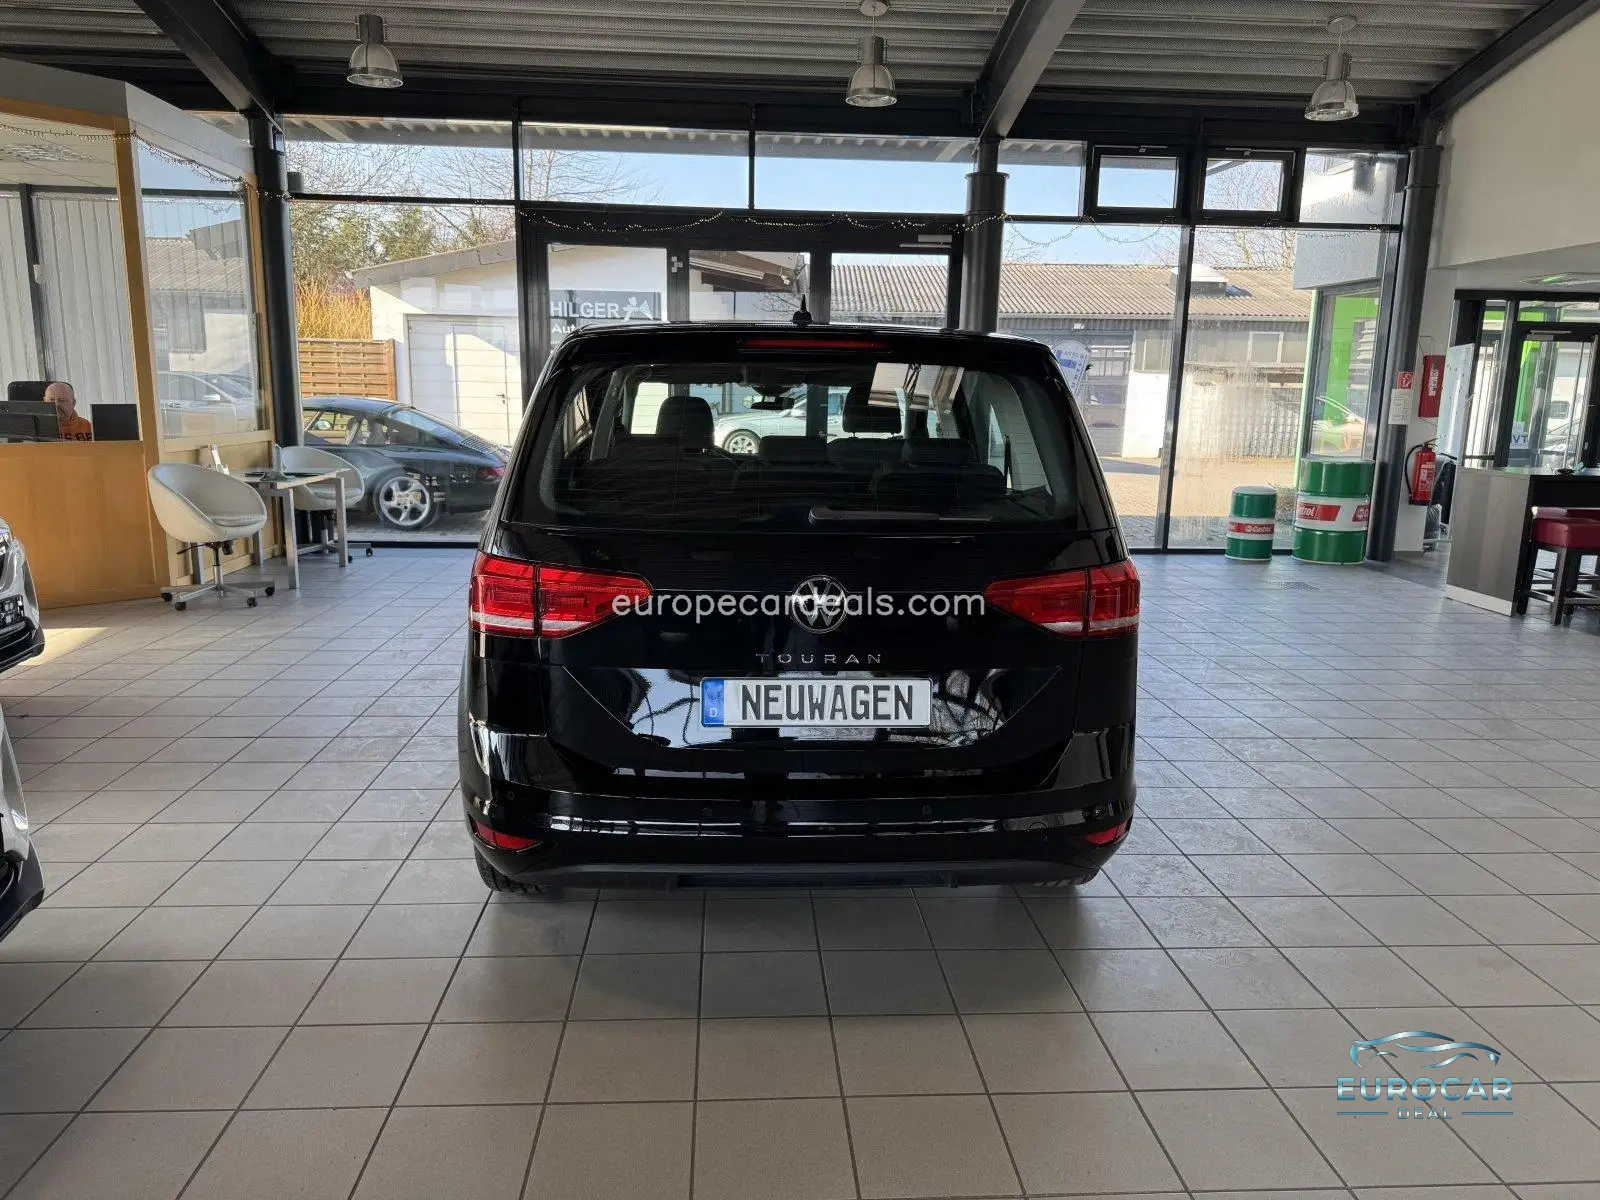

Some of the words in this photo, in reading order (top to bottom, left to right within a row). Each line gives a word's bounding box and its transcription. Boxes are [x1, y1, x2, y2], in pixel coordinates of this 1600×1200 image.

[550, 301, 621, 319] HILGER
[551, 323, 577, 334] Aut
[1252, 525, 1272, 533] Castrol
[755, 652, 882, 664] TOURAN
[709, 707, 718, 718] D
[741, 684, 914, 721] NEUWAGEN
